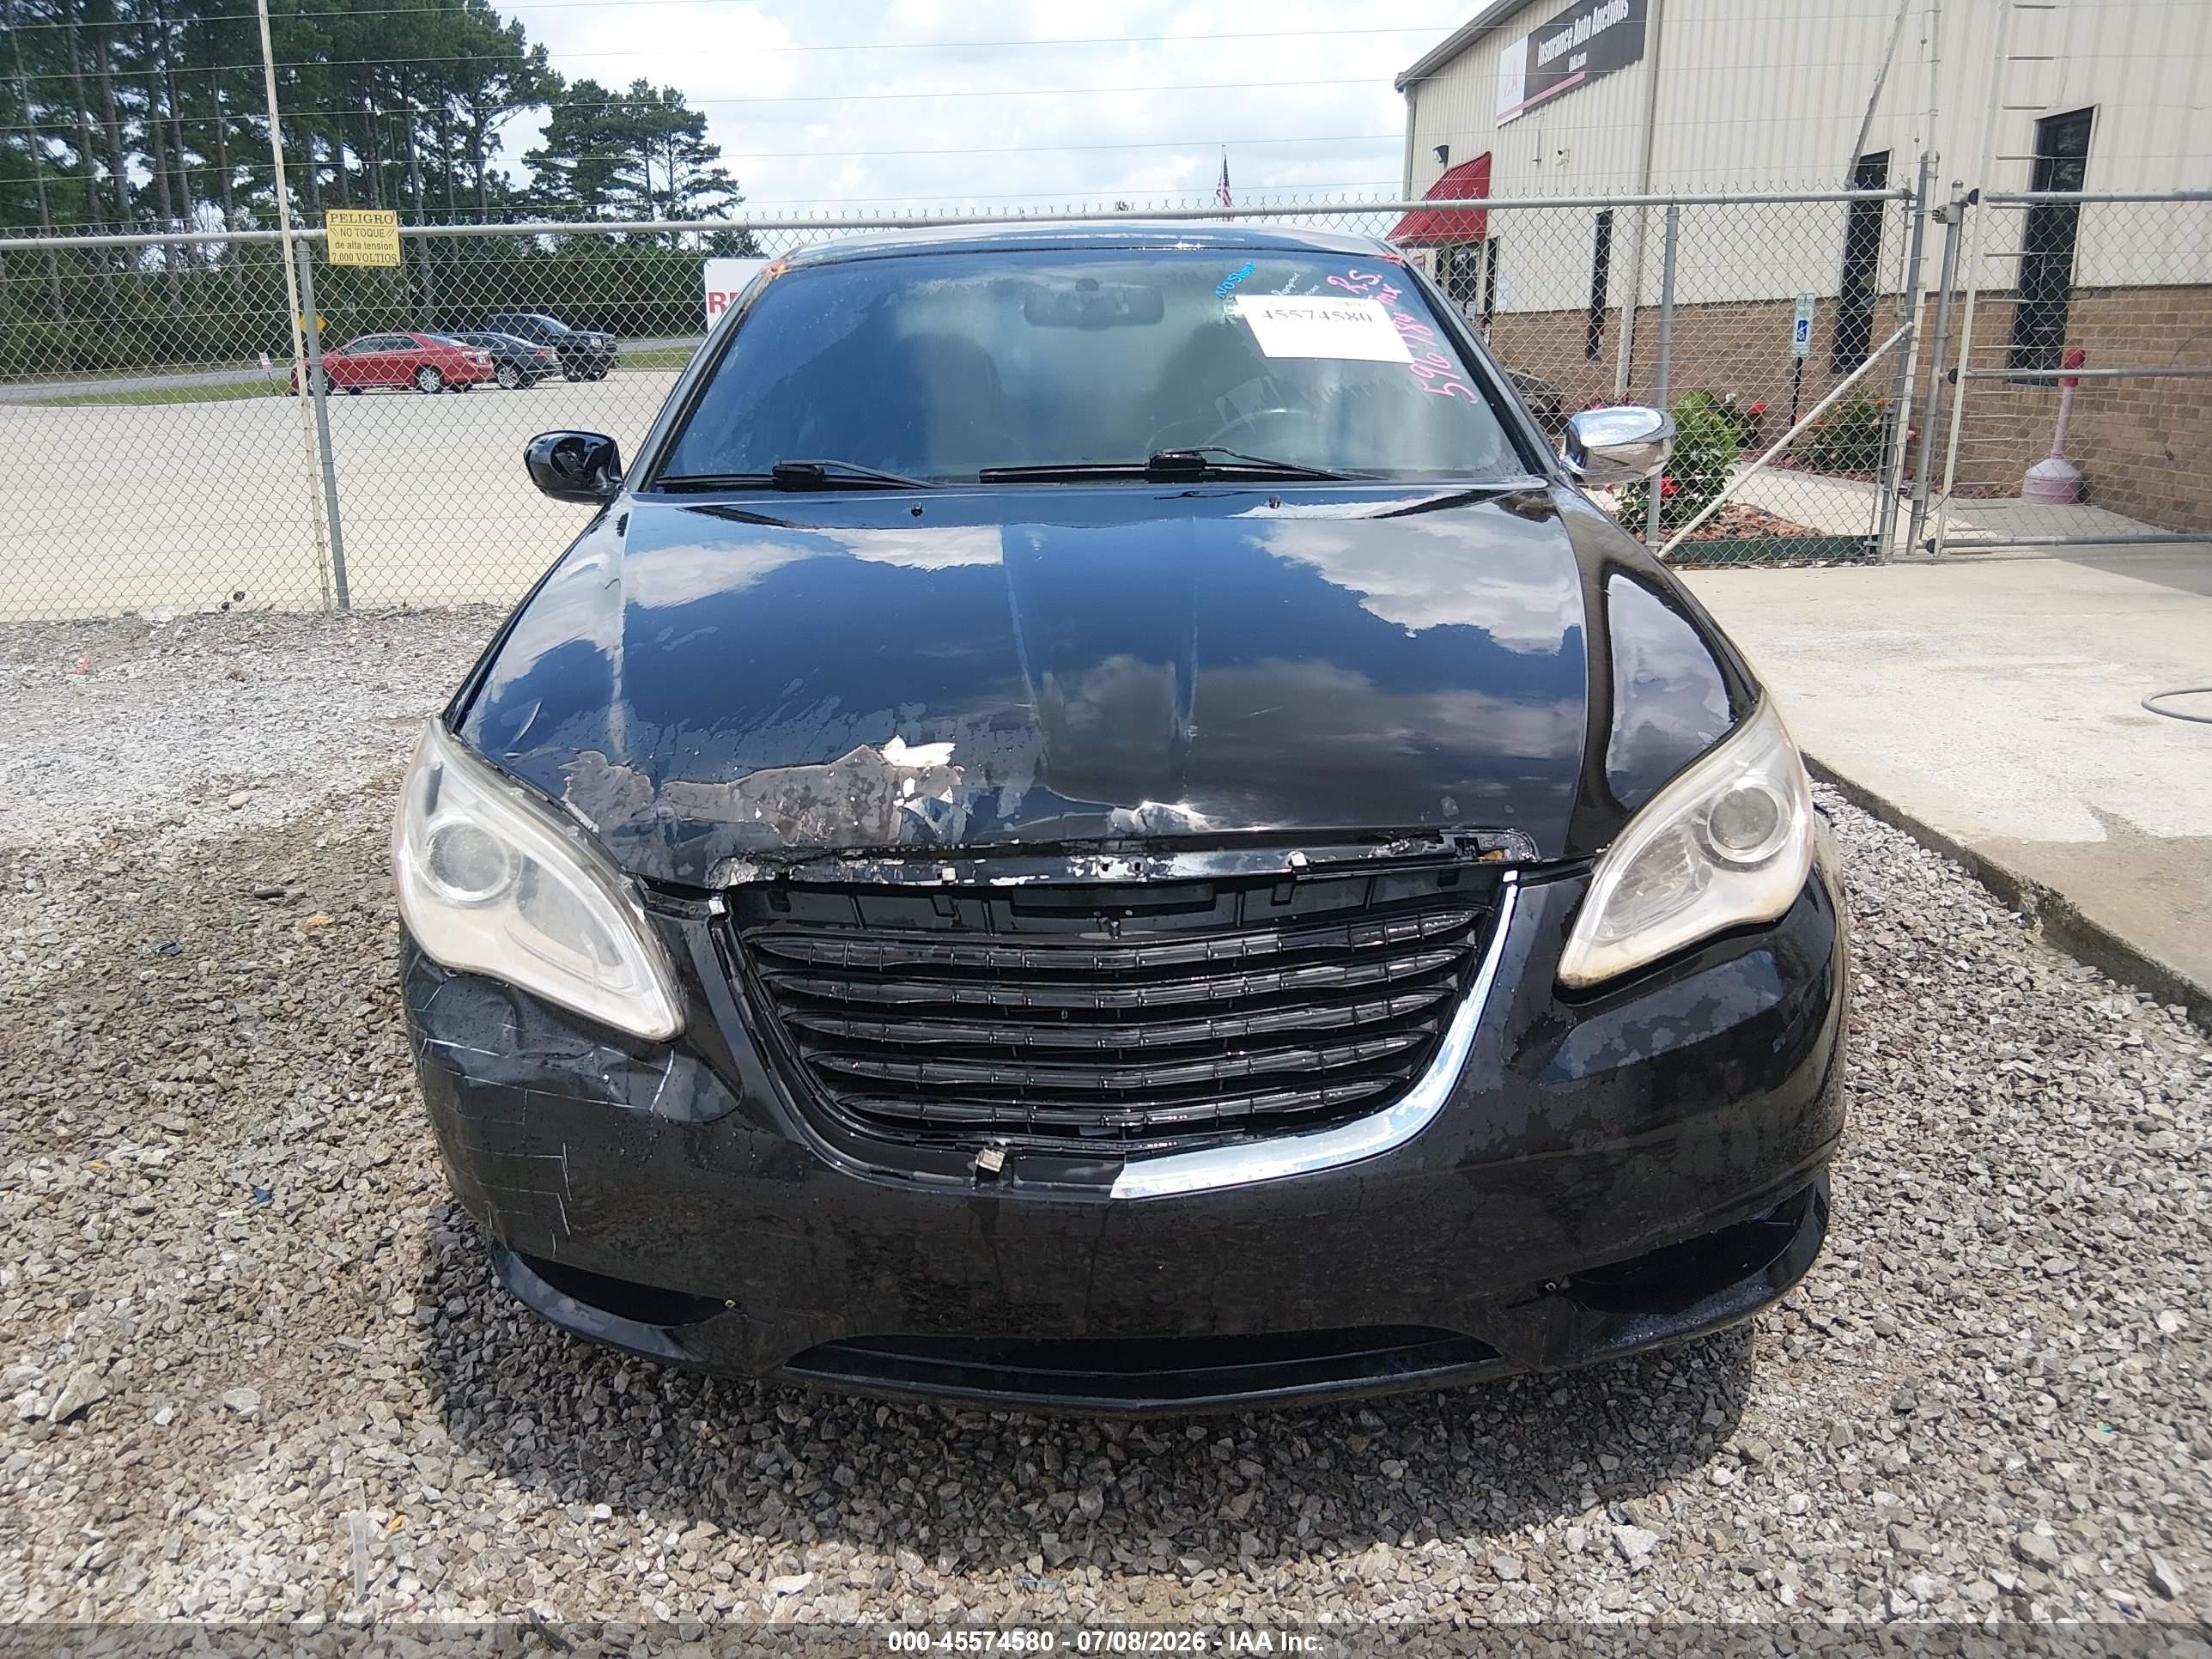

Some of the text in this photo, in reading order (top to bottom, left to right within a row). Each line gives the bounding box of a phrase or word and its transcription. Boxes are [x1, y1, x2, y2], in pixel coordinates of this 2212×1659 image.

[1538, 0, 1629, 68] Insurance Auto Auctions
[329, 213, 394, 225] PELIGRO
[340, 228, 386, 238] NO TOQUE
[335, 240, 394, 251] de alta tension
[355, 253, 398, 264] VOLTIOS
